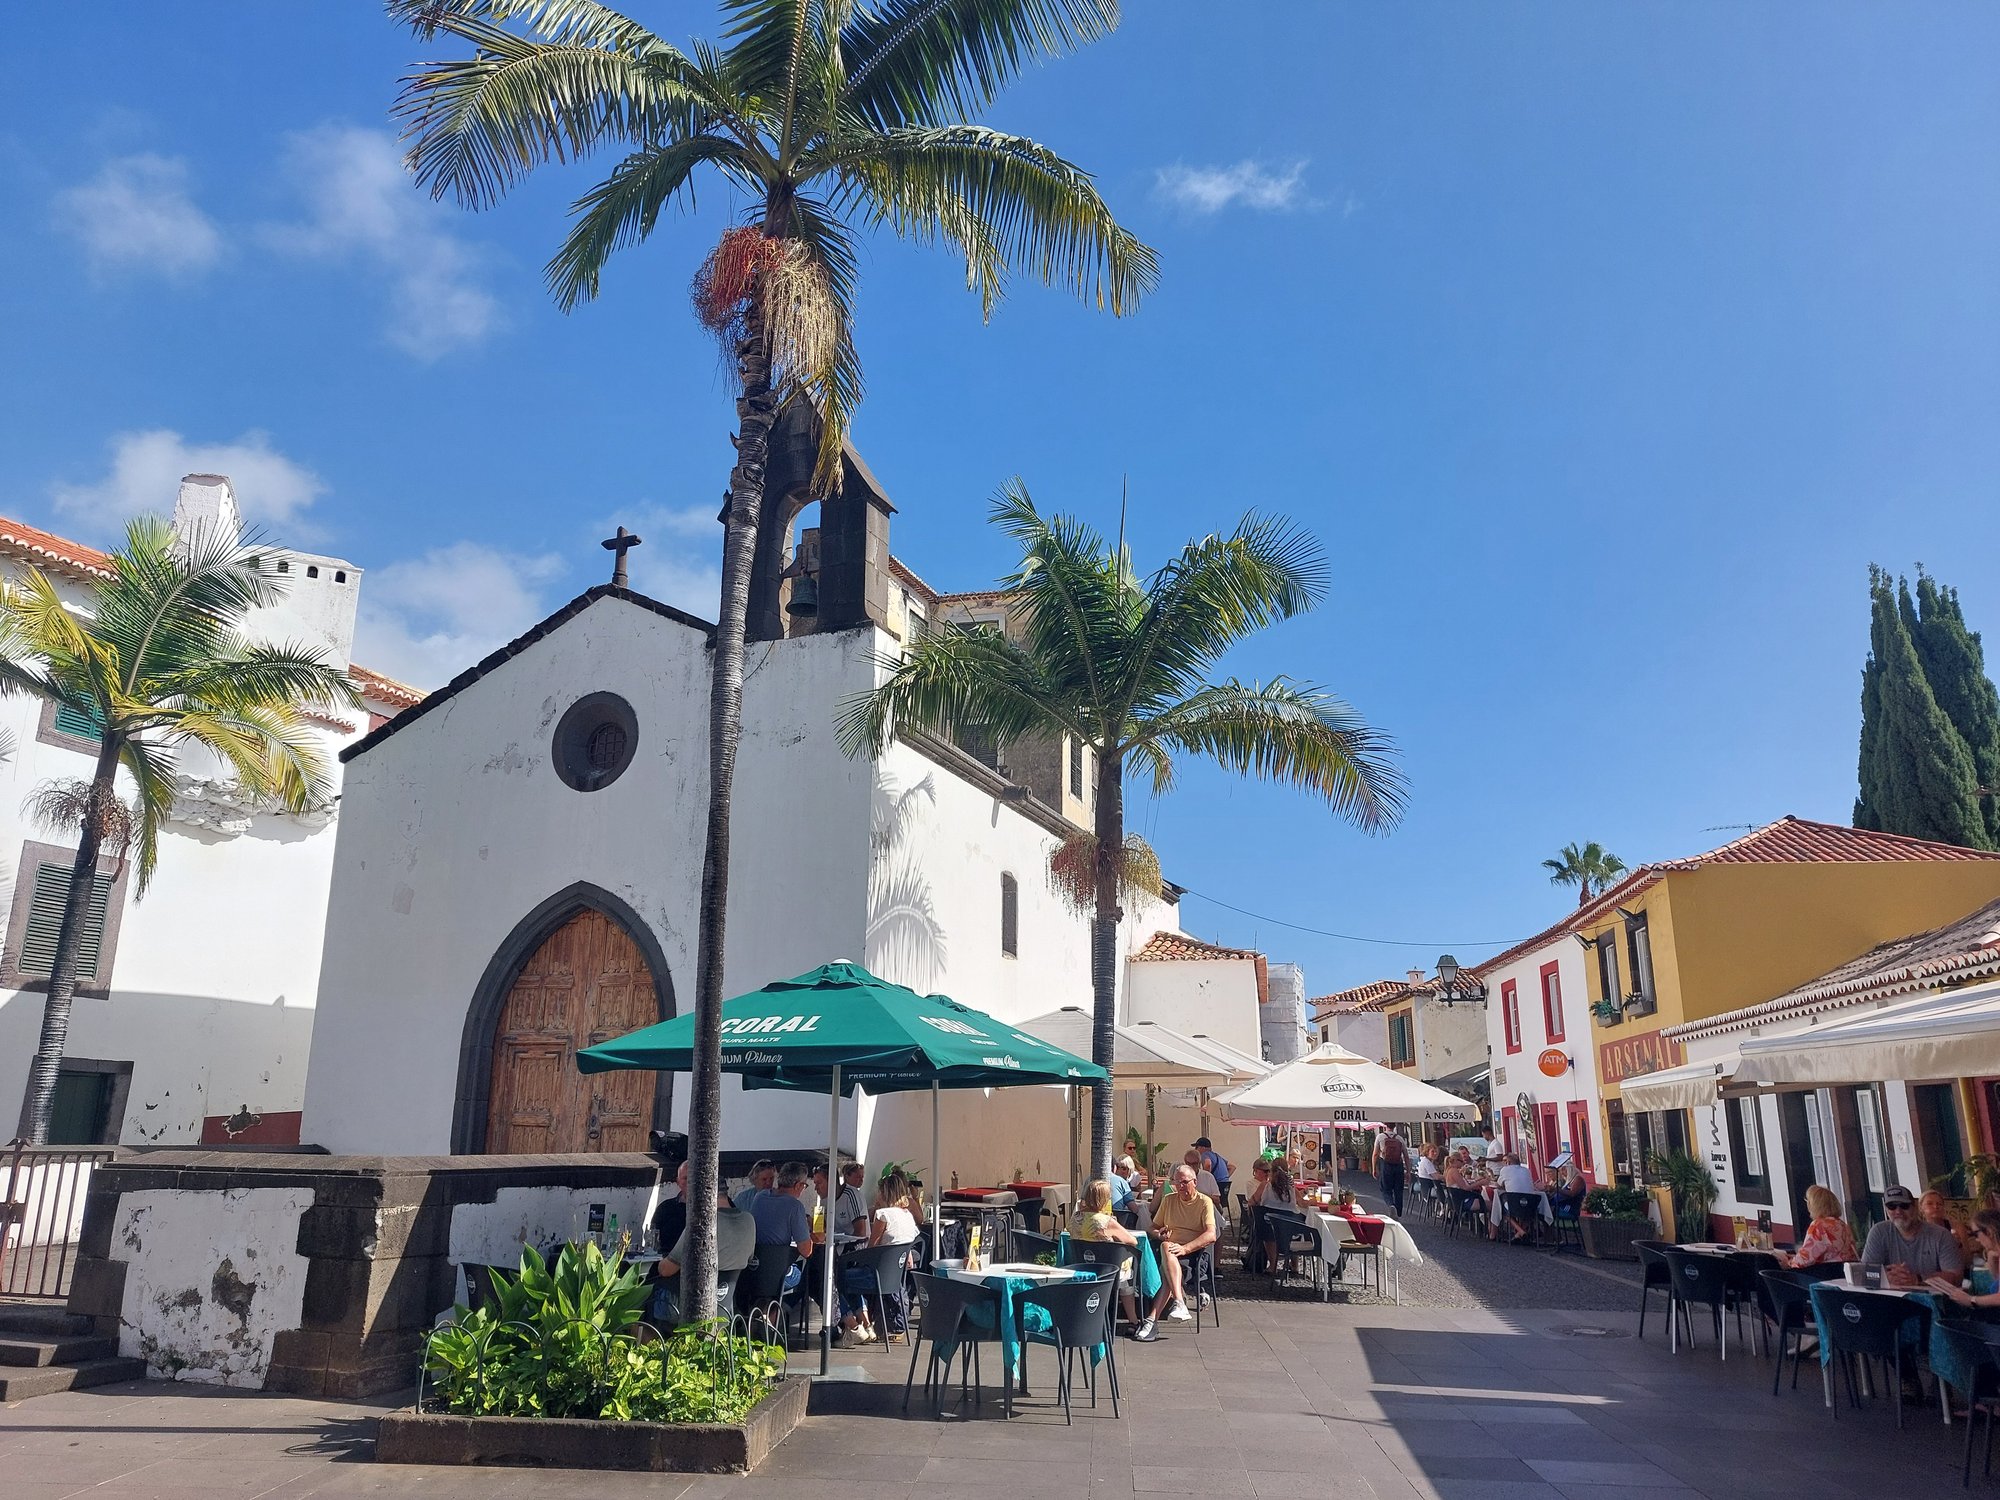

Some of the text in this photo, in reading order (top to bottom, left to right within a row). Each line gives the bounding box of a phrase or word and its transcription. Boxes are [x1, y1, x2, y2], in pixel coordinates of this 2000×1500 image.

[720, 1015, 822, 1034] CORAL
[744, 1050, 784, 1065] Pilsner
[1543, 1055, 1565, 1064] ATM
[1606, 1036, 1676, 1079] ARSENAL
[1326, 1083, 1362, 1092] CORAL
[1334, 1110, 1466, 1121] CORAL À NOSSA
